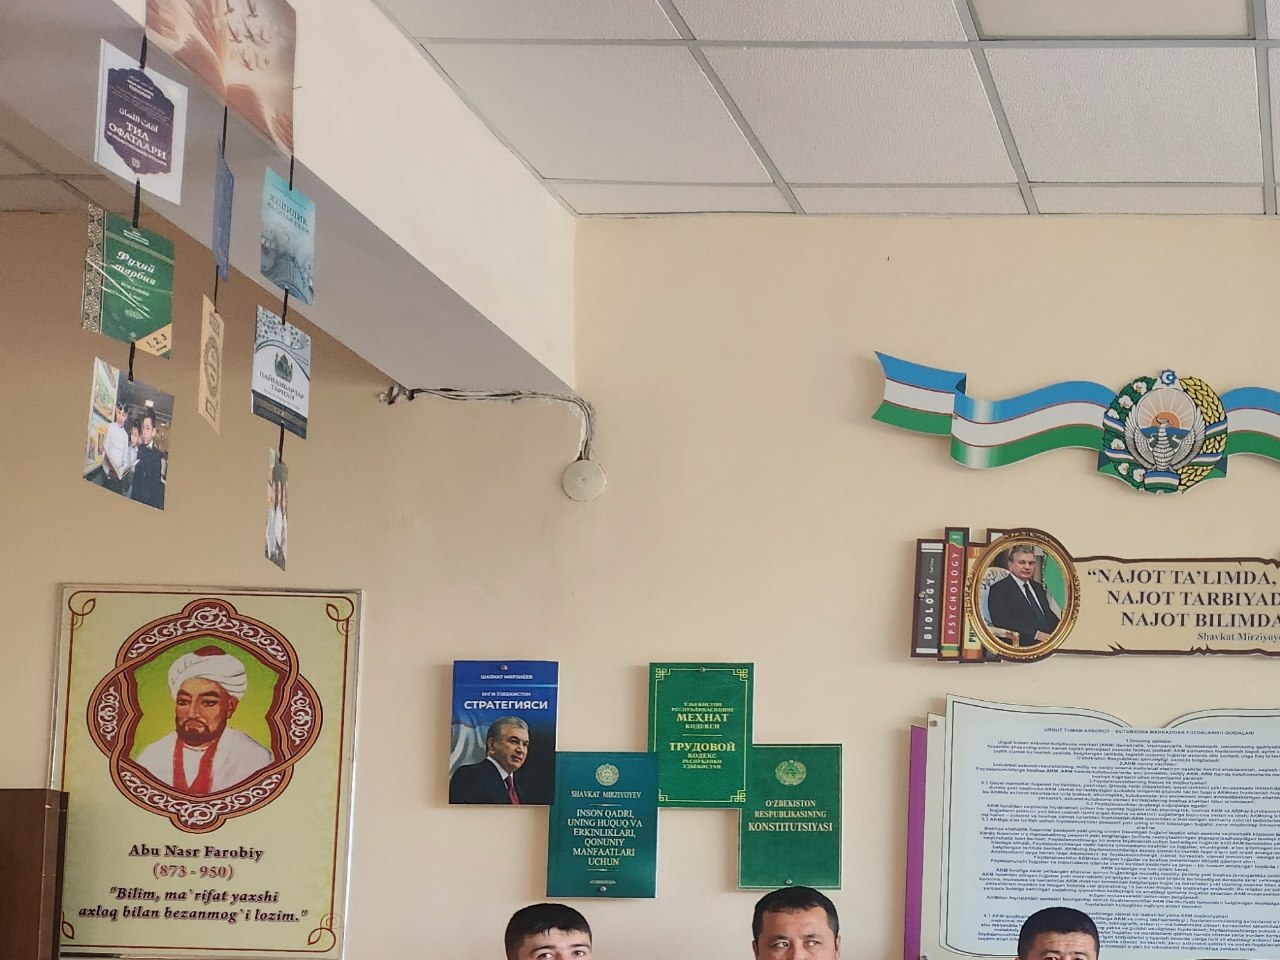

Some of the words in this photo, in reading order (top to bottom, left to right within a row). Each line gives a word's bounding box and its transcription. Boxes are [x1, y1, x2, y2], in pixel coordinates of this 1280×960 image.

[948, 553, 959, 634] PSYCHOLOGY
[1107, 590, 1175, 605] NAJOT
[924, 579, 934, 640] BIOLOGY
[1121, 612, 1189, 626] NAJOT
[1197, 632, 1234, 641] Shavkat
[464, 701, 548, 709] СТРАТЕГИЯСИ
[669, 741, 736, 752] ТРУДОВОЙ
[605, 810, 634, 818] QADRI,
[598, 819, 629, 828] HUQUQ
[748, 822, 832, 831] KONSTITUTSIYASI
[574, 829, 636, 838] ERKINLIKLARI,
[584, 838, 625, 847] QONUNIY
[129, 844, 159, 857] Abu
[164, 845, 200, 858] Nasr
[204, 846, 265, 862] Farobiy
[573, 848, 635, 856] MANFAATLARI
[231, 891, 279, 903] yaxshi
[78, 906, 118, 919] axloq
[123, 906, 159, 918] bilan
